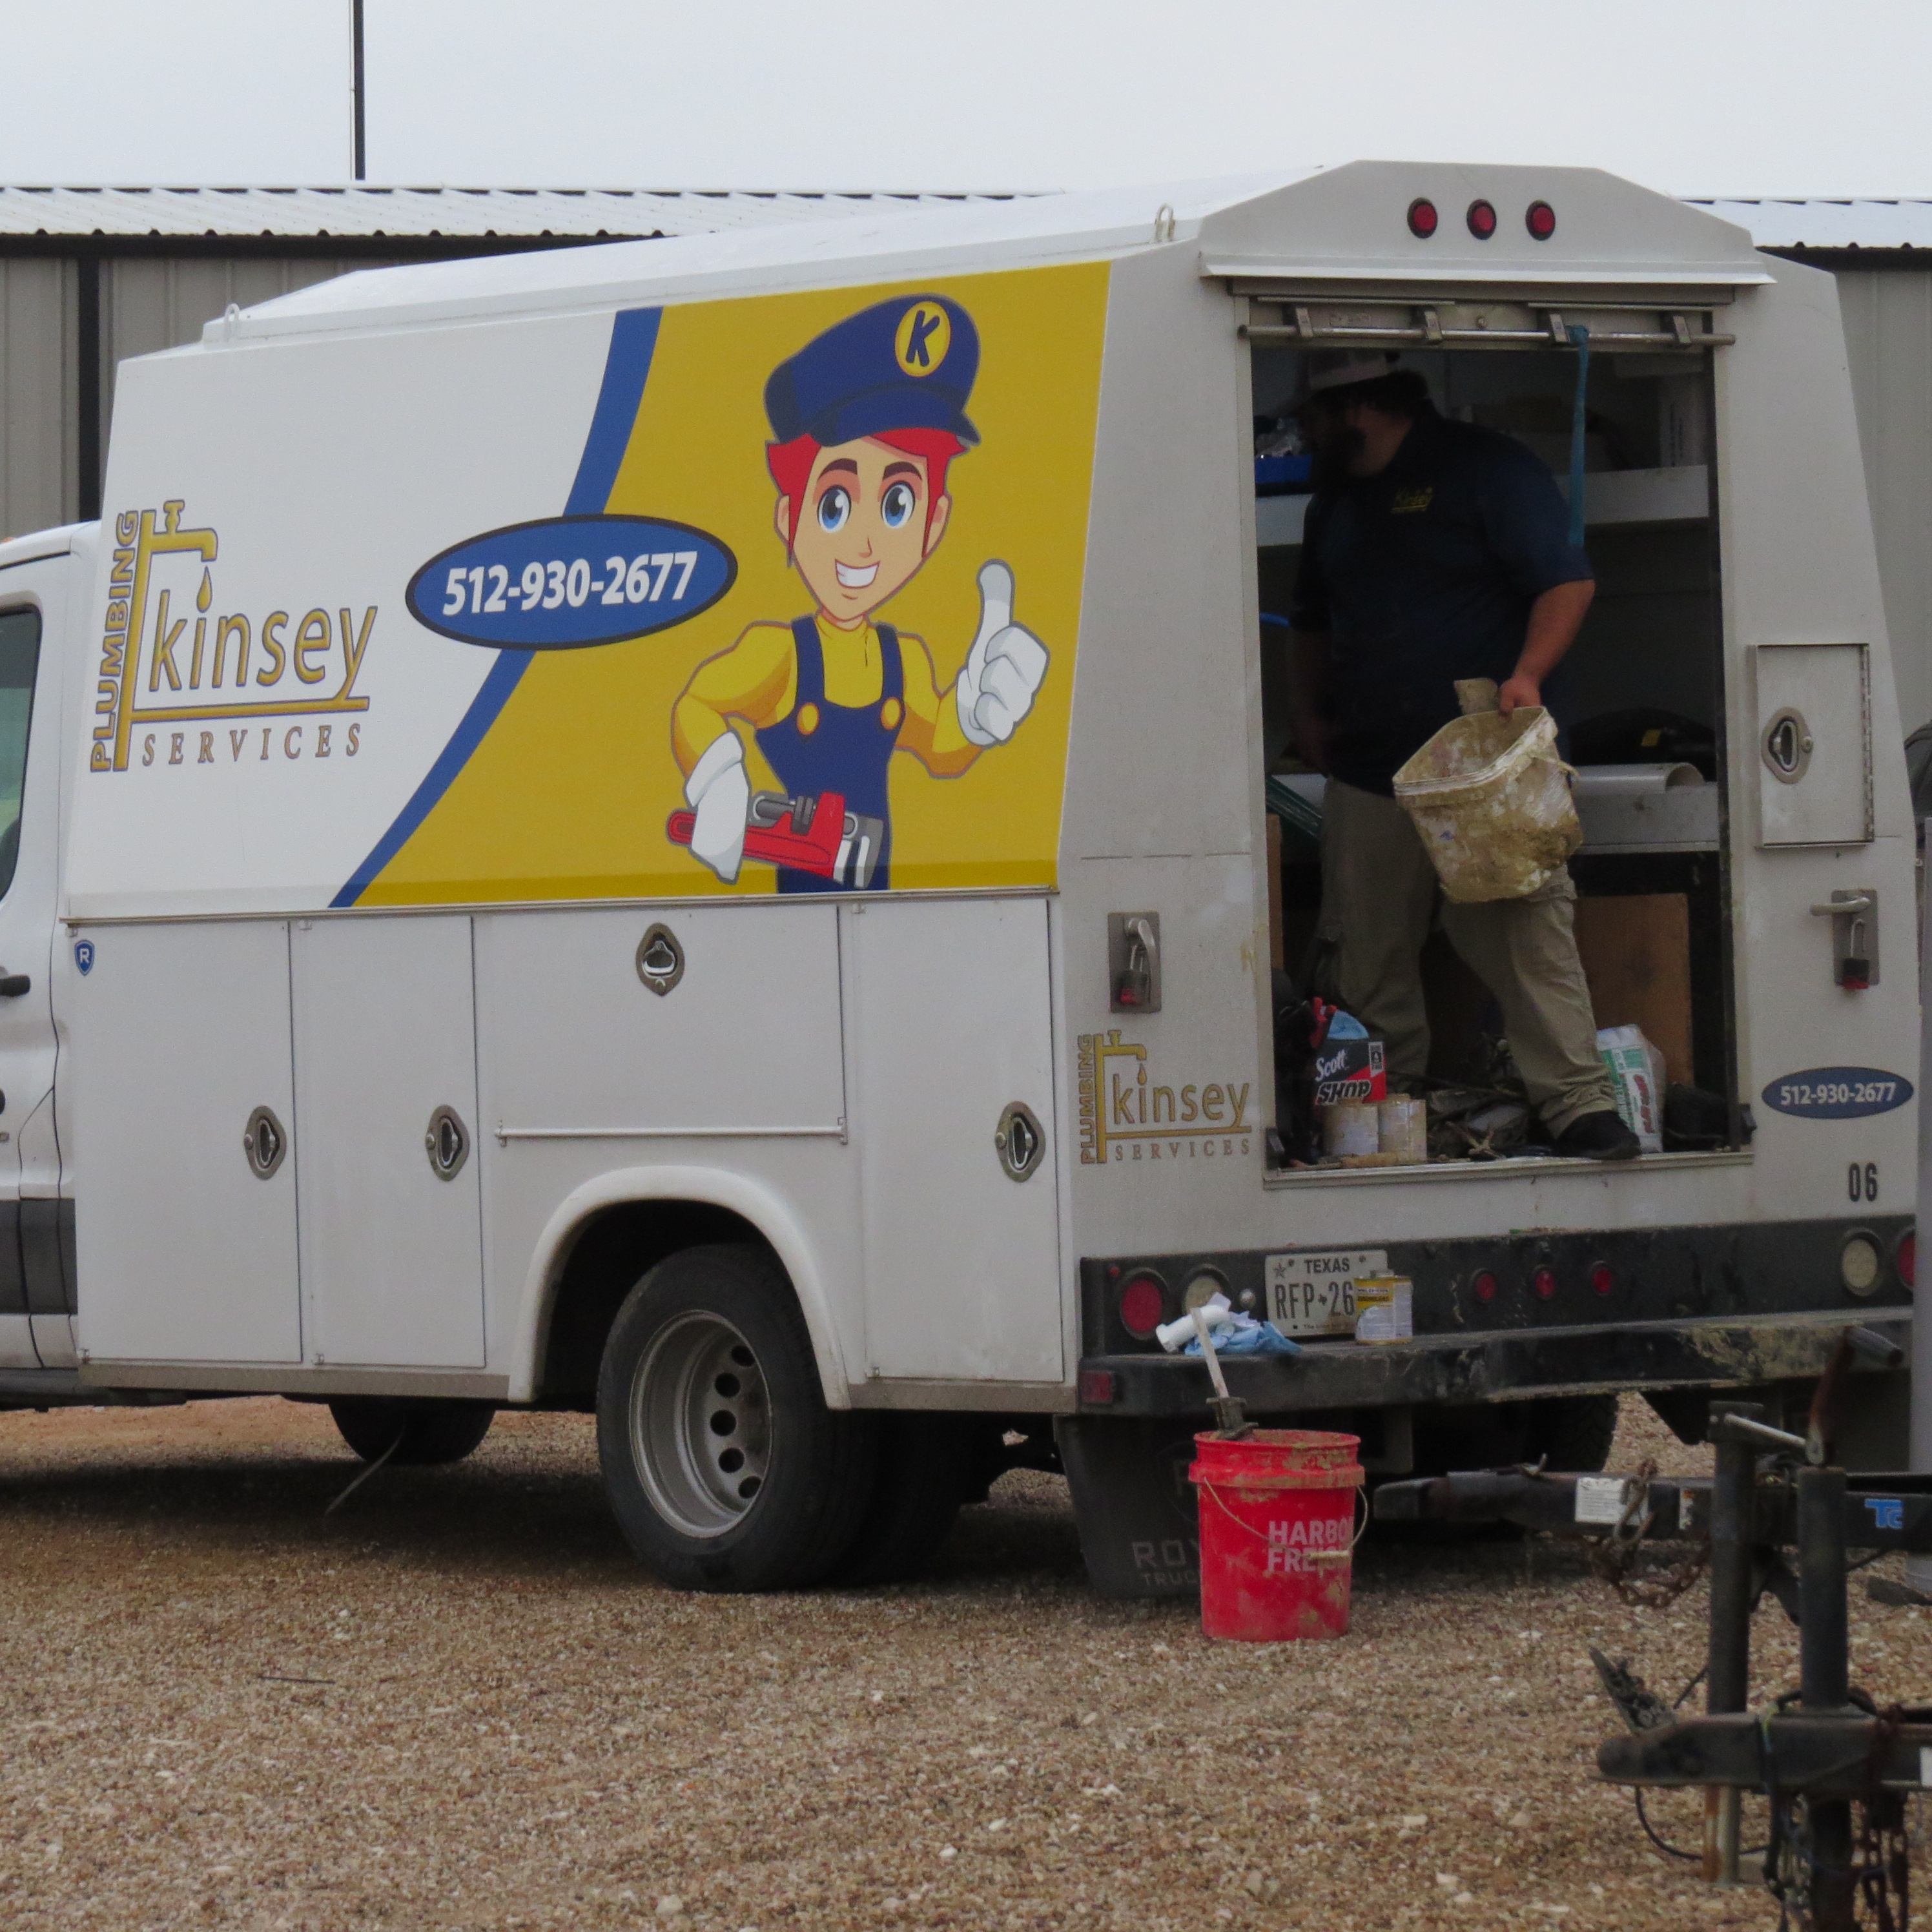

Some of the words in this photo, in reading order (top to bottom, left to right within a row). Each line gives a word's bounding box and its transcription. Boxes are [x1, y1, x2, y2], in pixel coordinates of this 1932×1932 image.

[905, 310, 940, 367] K
[442, 550, 698, 617] 512-930-2677
[90, 510, 139, 772] PLUMBING
[149, 589, 378, 701] kinsey
[142, 723, 361, 766] SERVICES
[79, 948, 90, 964] R
[1314, 1048, 1346, 1082] Scott
[1077, 1034, 1096, 1165] PLUMBING
[1113, 1073, 1250, 1127] kinsey
[1317, 1079, 1372, 1106] SHOP
[1780, 1082, 1897, 1106] 512-930-2677
[1115, 1138, 1250, 1161] SERVICES
[1848, 1162, 1878, 1202] 06
[1304, 1257, 1350, 1274] TEXAS
